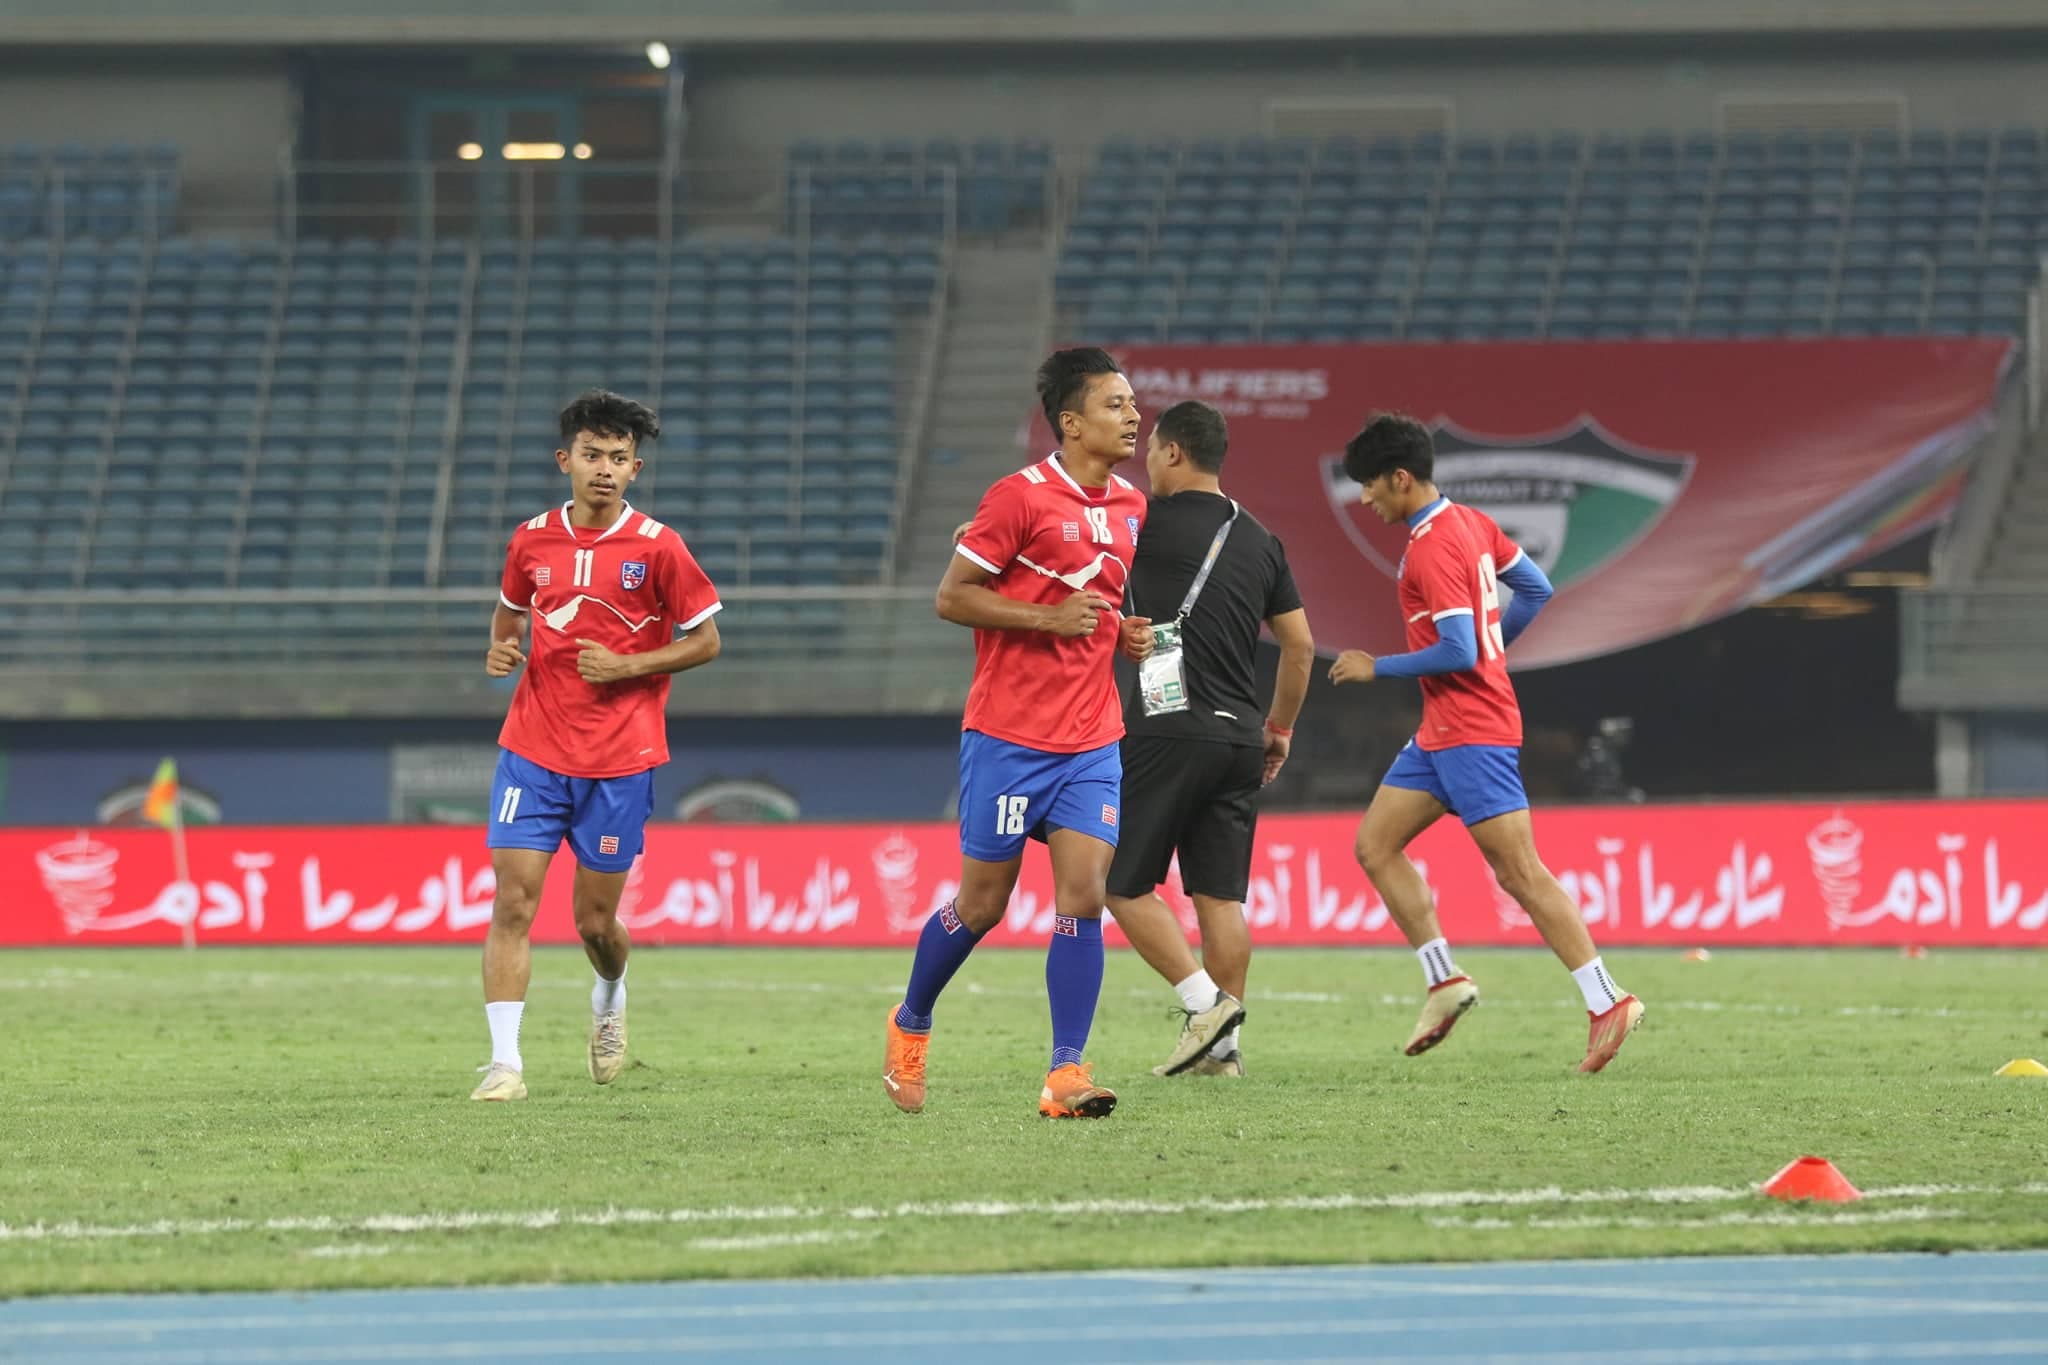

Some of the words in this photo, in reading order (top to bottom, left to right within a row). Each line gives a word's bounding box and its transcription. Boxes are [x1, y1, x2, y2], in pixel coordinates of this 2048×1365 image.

[1128, 367, 1328, 399] UALIFIERS
[1083, 506, 1114, 545] 18
[573, 549, 595, 587] 11
[498, 786, 522, 824] 11
[996, 795, 1029, 835] 18
